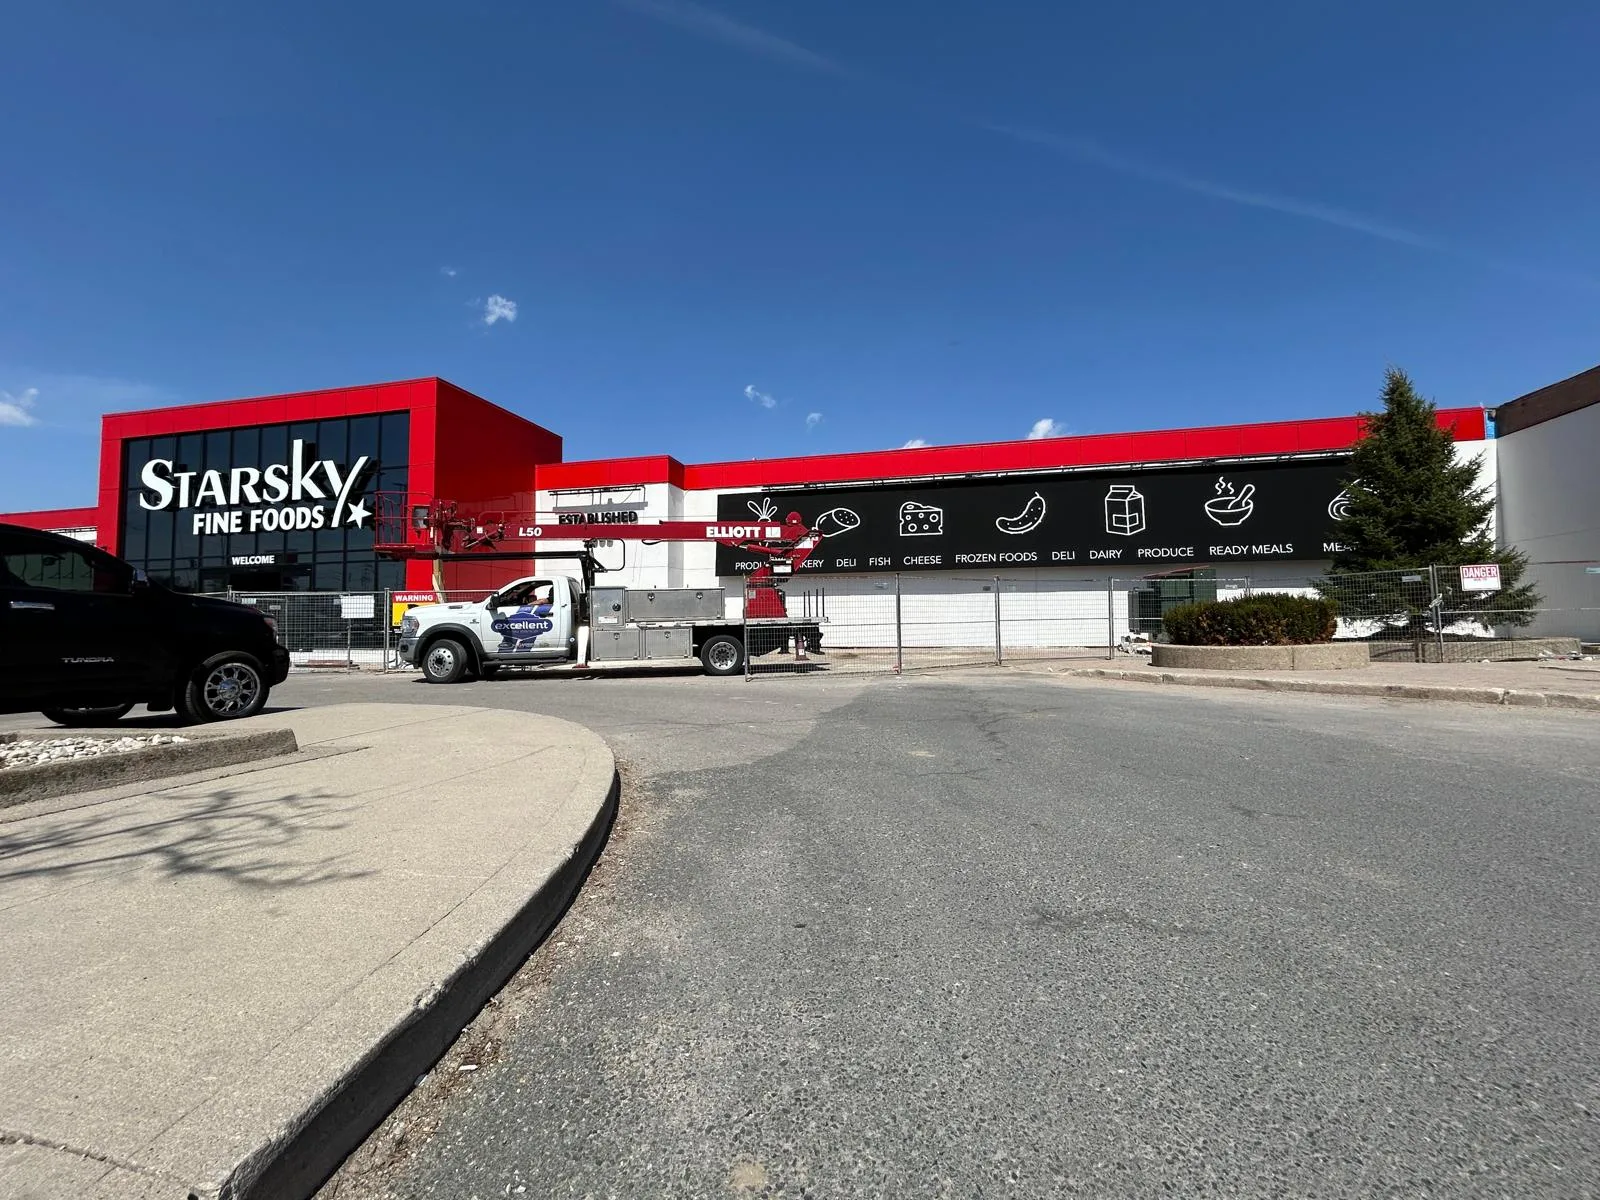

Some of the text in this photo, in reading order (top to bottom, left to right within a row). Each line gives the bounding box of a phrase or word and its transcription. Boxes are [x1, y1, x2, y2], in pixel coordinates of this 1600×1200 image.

[192, 505, 325, 535] FINE FOODS
[558, 511, 638, 525] ESTABLISHED
[518, 527, 542, 537] L50
[706, 526, 761, 538] ELLIOTT
[231, 555, 275, 566] WELCOME
[836, 558, 857, 567] DELI
[869, 557, 891, 566] FISH
[903, 555, 942, 565] CHEESE
[955, 553, 996, 564] FROZEN
[999, 552, 1038, 562] FOODS
[1051, 551, 1075, 561] DELI
[1089, 549, 1123, 559] DAIRY
[1137, 547, 1195, 558] PRODUCE
[1209, 545, 1249, 556] READY
[1252, 543, 1294, 554] MEALS
[1462, 566, 1497, 578] DANGER
[395, 594, 434, 602] WARNING
[494, 620, 549, 630] excellent
